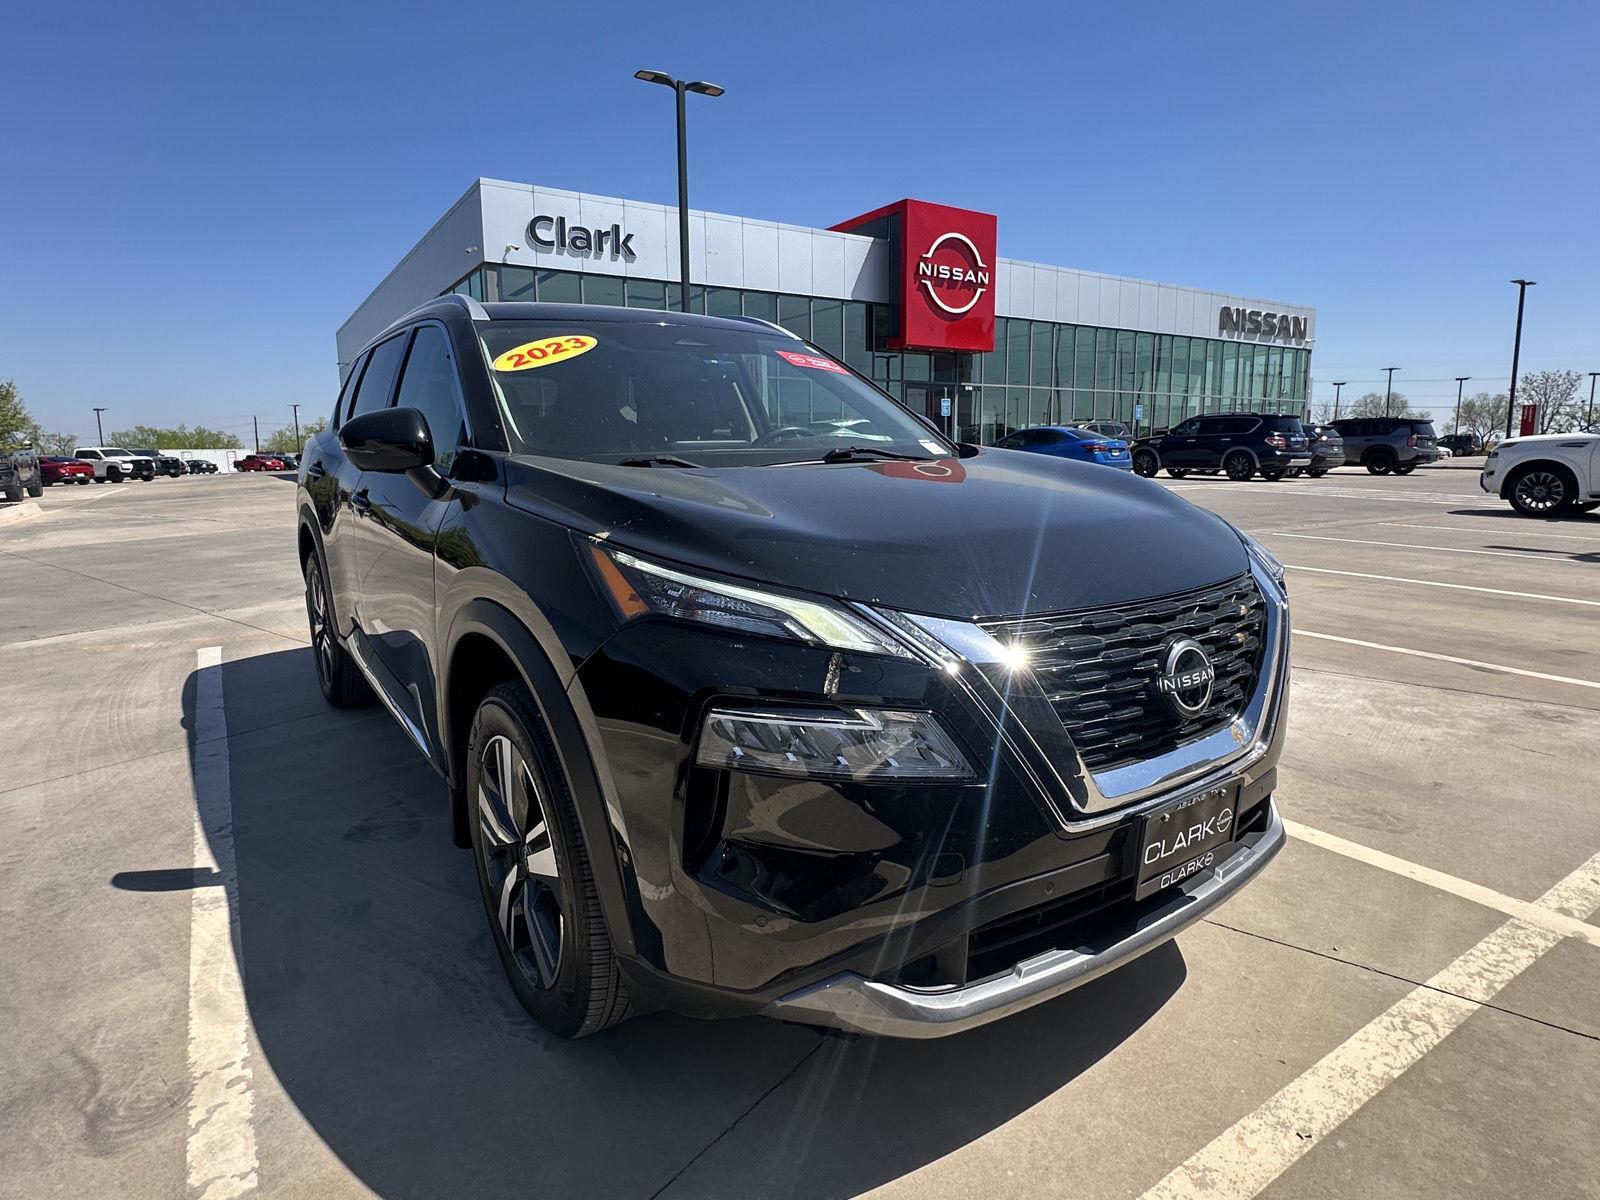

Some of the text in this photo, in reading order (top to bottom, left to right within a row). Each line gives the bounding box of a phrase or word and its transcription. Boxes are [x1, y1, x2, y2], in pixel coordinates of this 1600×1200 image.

[526, 215, 637, 260] Clark
[919, 262, 989, 285] NISSAN
[1219, 306, 1308, 342] NISSAN
[507, 337, 588, 368] 2023
[1164, 666, 1215, 691] NISSAN
[1144, 816, 1216, 865] CLARK
[1161, 856, 1205, 889] CLARK
